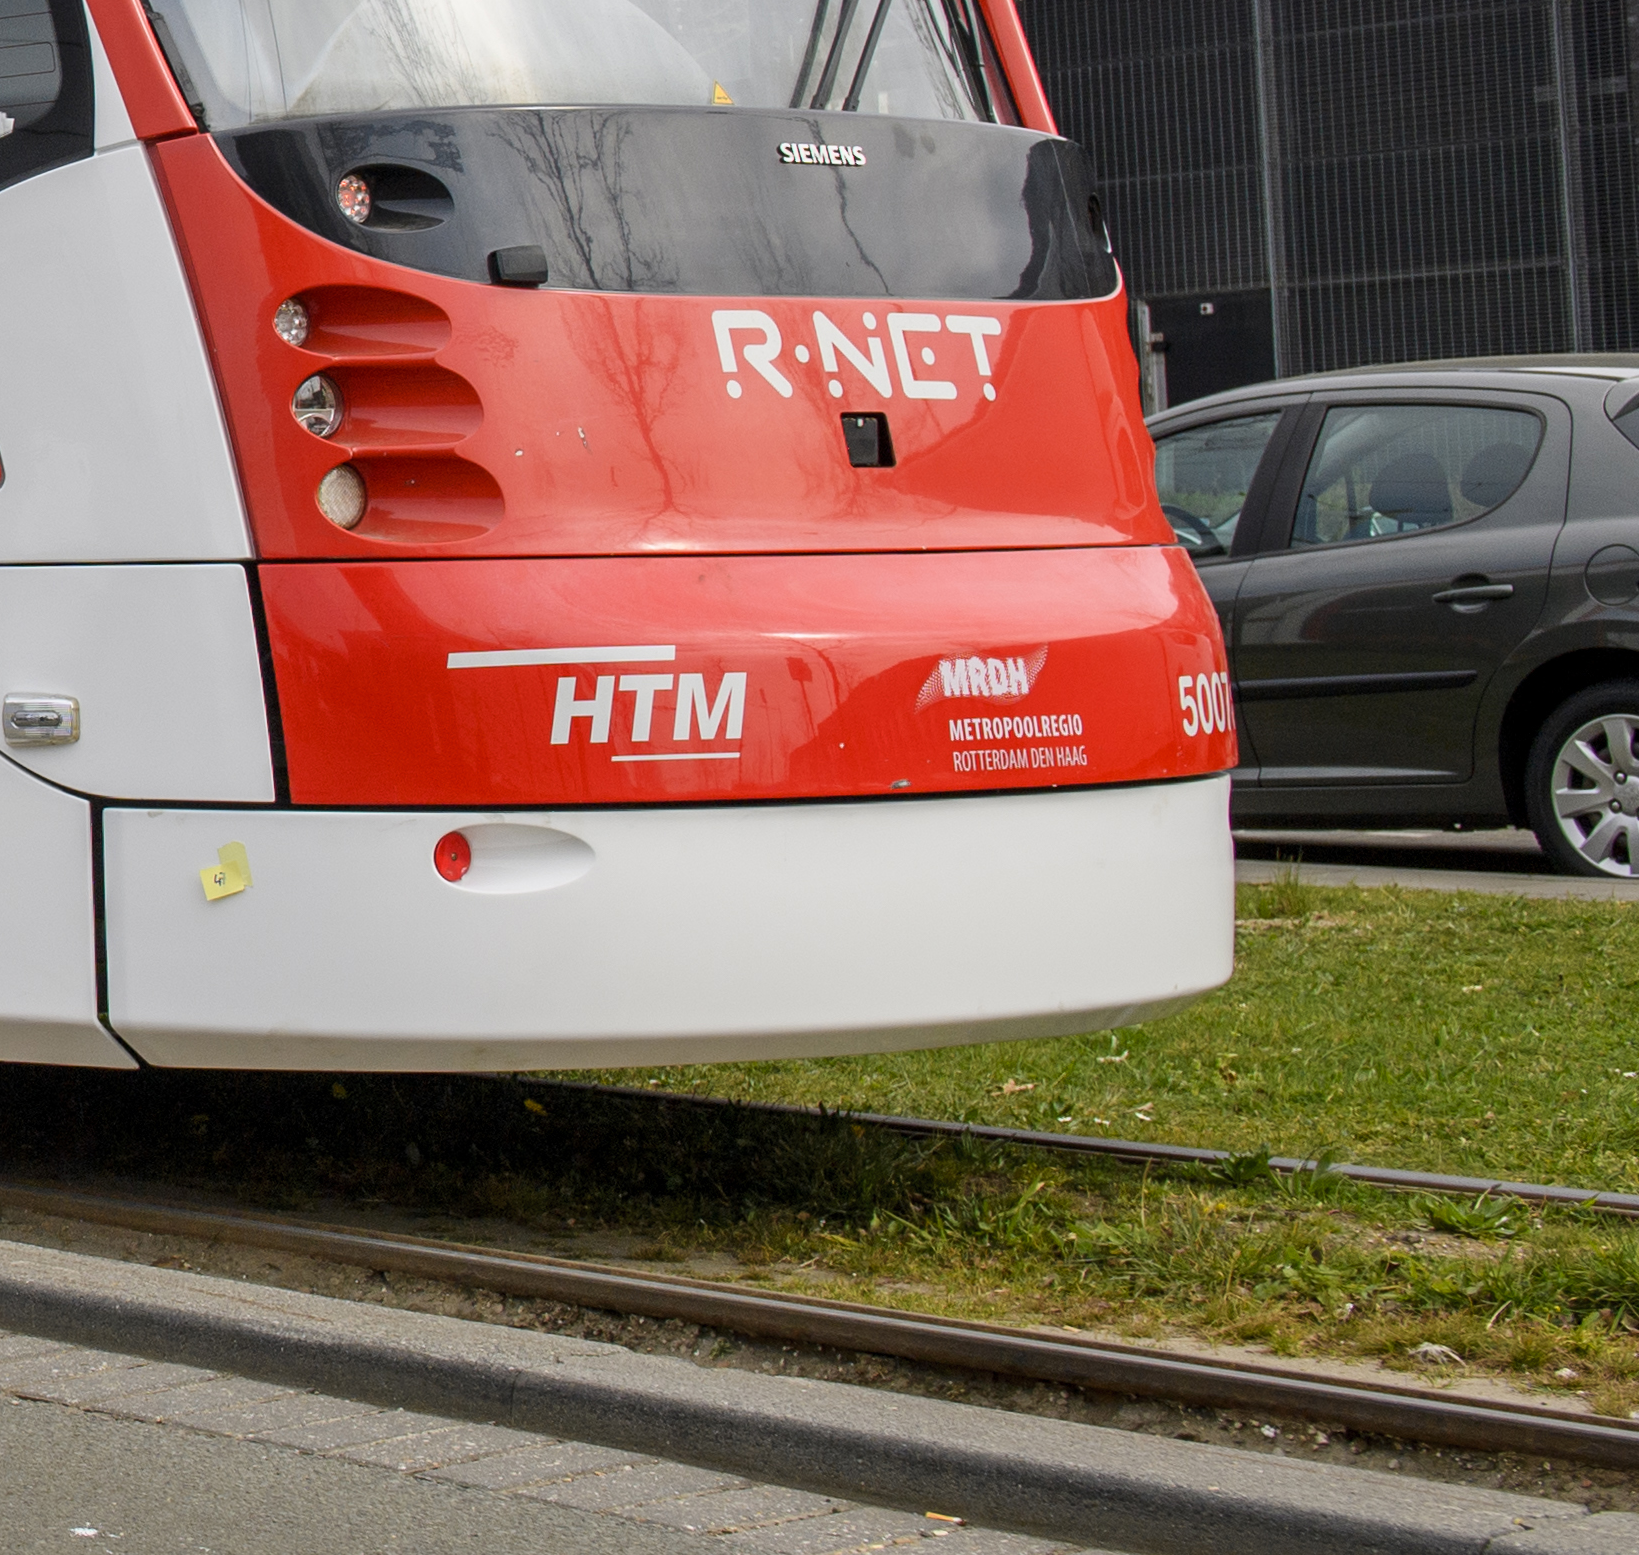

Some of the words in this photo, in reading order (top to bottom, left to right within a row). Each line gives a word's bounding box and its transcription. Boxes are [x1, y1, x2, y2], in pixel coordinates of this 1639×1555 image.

[776, 142, 867, 167] SIEMENS
[939, 656, 1030, 697] MRDH
[550, 671, 748, 745] HTM
[948, 713, 1083, 741] METROPOOLREGIO
[952, 748, 1029, 772] ROTTERDAM
[1030, 747, 1055, 769] DEN
[1056, 745, 1088, 766] HAAG
